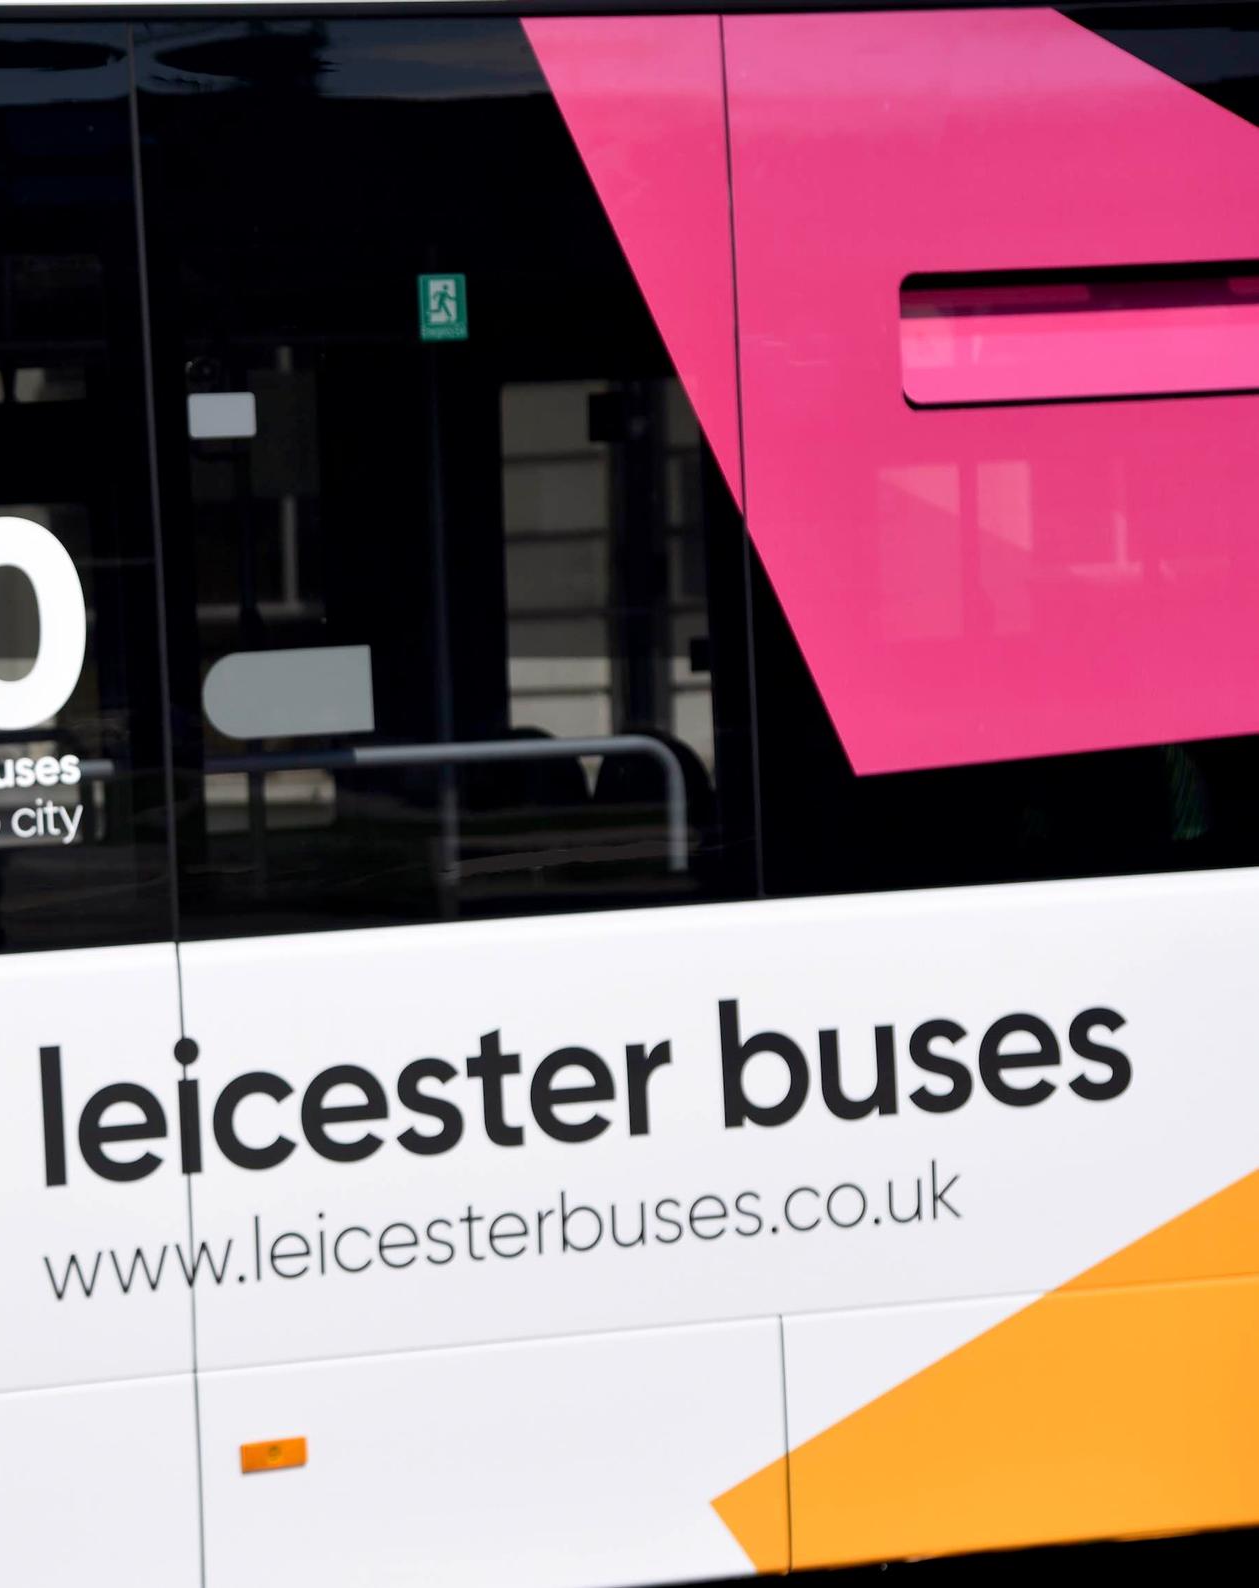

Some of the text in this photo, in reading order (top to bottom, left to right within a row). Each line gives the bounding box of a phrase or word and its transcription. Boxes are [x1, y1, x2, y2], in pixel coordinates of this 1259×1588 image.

[11, 798, 84, 844] city
[39, 999, 1133, 1188] leicester buses
[43, 1159, 962, 1302] www.leicesterbuses.co.uk
